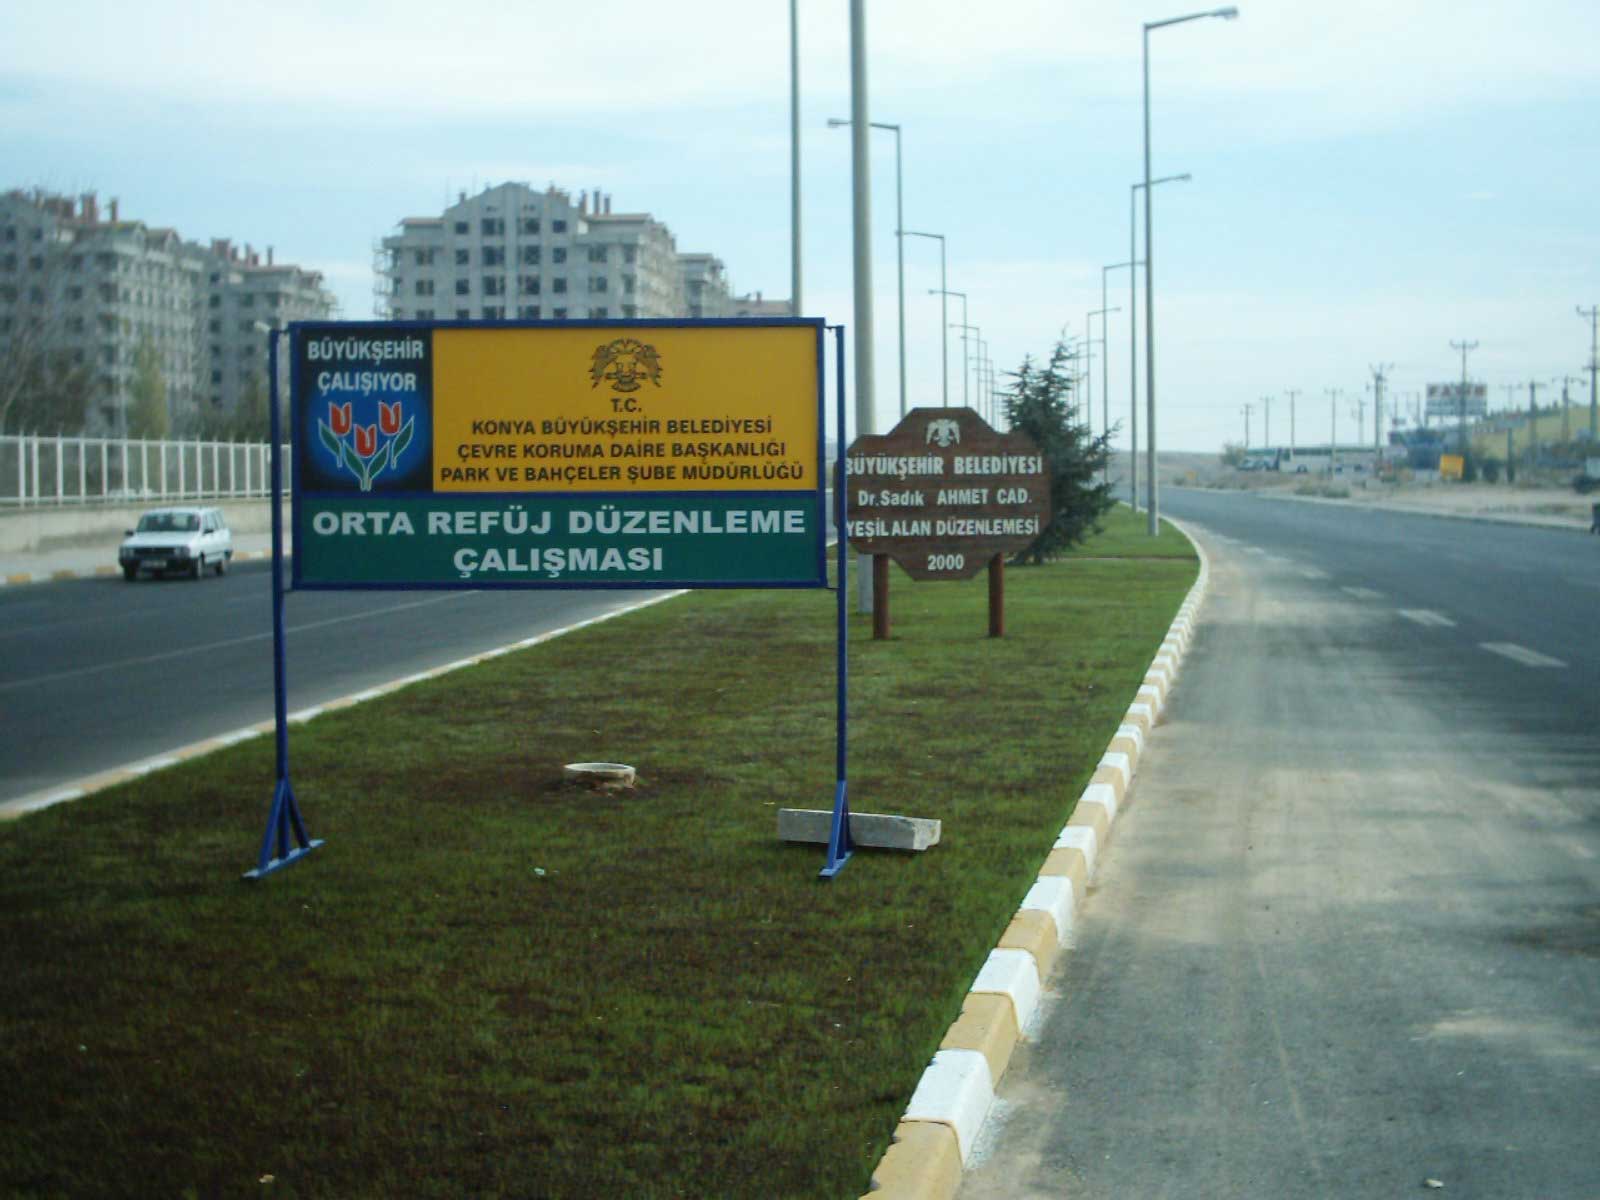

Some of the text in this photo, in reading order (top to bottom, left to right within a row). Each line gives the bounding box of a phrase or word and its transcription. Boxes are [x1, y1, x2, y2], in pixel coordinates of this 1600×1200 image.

[307, 336, 424, 365] BÜYÜKŞEHİR
[318, 371, 417, 396] ÇALIŞIYOR
[611, 398, 642, 412] T.C.
[472, 416, 772, 438] KONYA BÜYÜKŞEHİR BELEDİYESİ
[458, 437, 785, 464] ÇEVRE KORUMA DAİRE BAŞKANLIĞI
[441, 461, 803, 484] PARK VE BAHÇELER ŞUBE MÜDÜRLÜĞÜ
[954, 452, 1042, 474] BELEDİYESİ
[937, 489, 988, 505] AHMET
[313, 505, 805, 535] ORTA REFÜJ DÜZENLEME
[892, 520, 931, 536] ALAN
[936, 515, 1039, 535] DÜZENLEMESİ
[453, 548, 663, 578] ÇALIŞMASI
[928, 554, 964, 570] 2000
